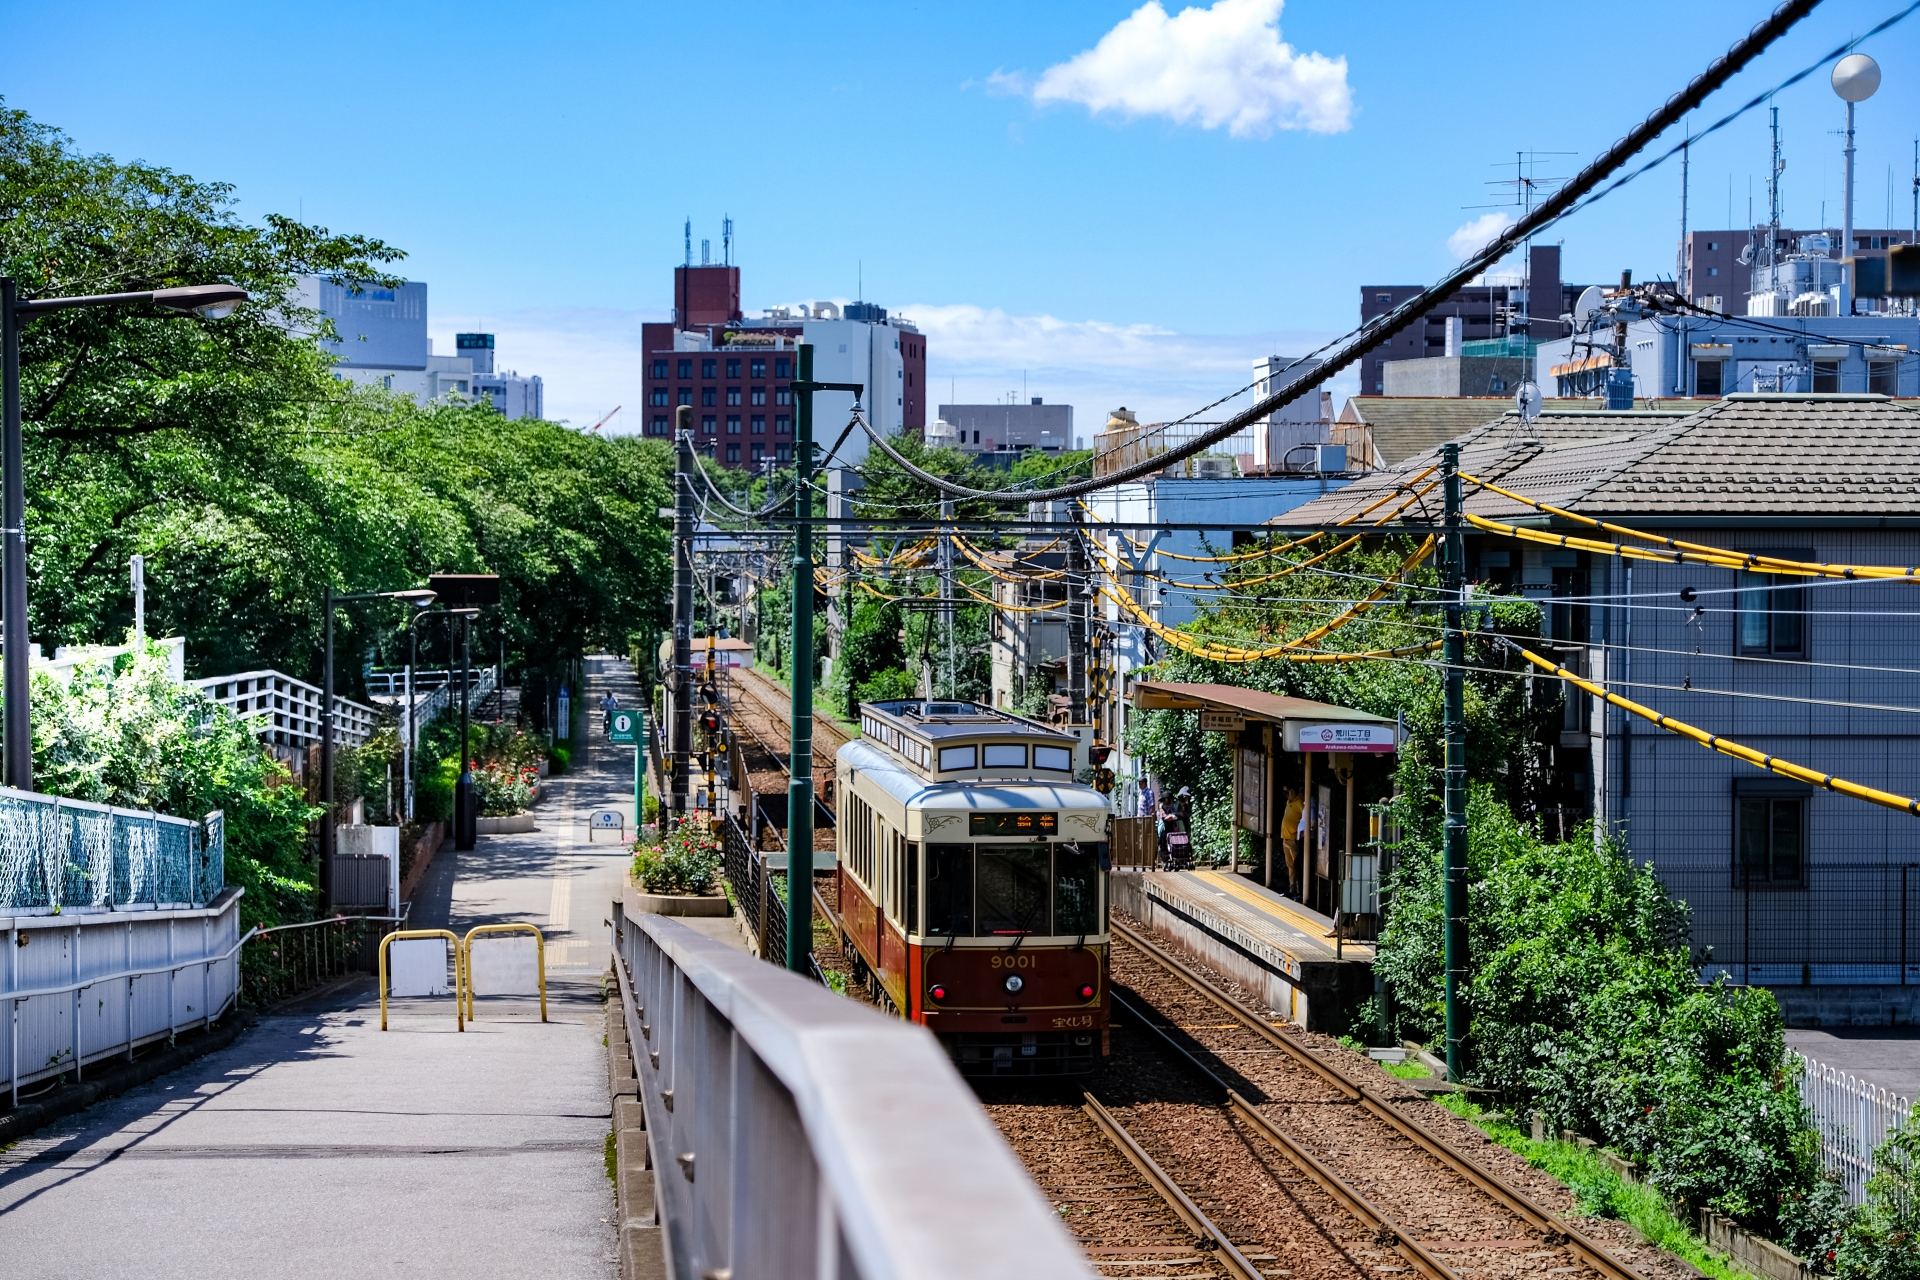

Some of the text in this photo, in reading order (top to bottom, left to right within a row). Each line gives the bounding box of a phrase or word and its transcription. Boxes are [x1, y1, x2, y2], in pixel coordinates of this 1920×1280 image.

[1335, 729, 1371, 738] 荒川二丁目
[991, 955, 1036, 969] 9001
[1052, 1015, 1093, 1028] 宝くじ号
